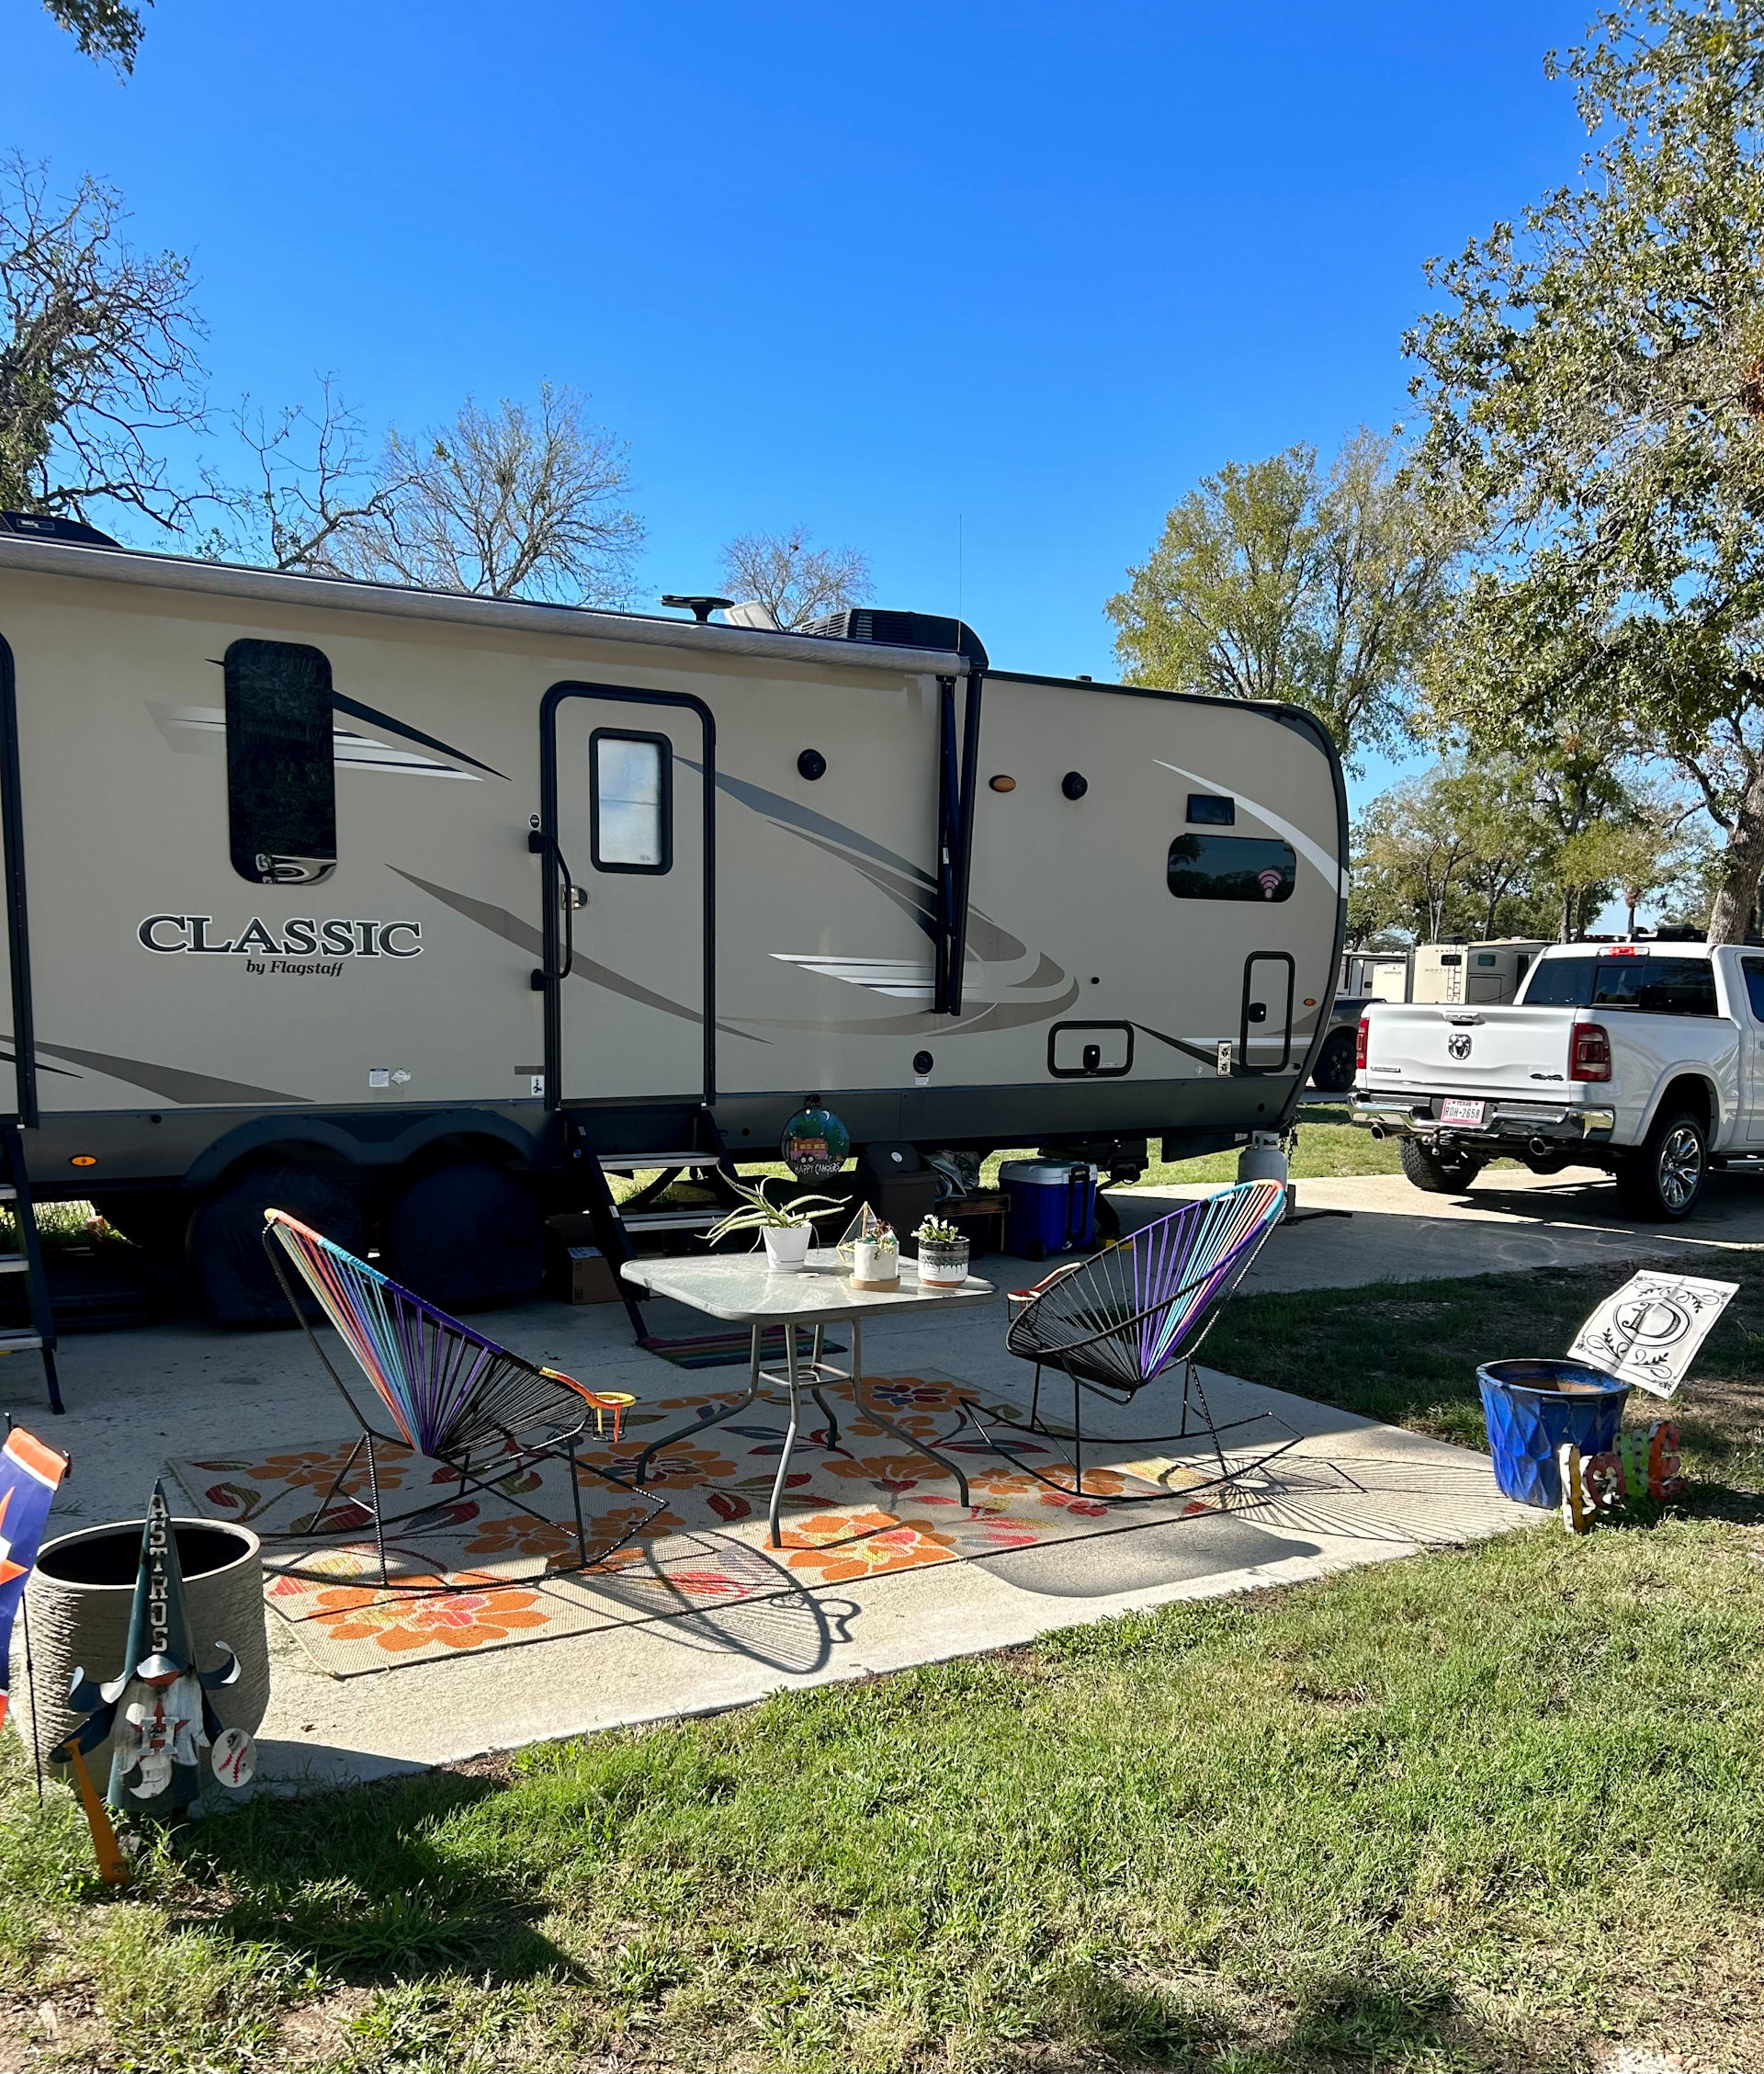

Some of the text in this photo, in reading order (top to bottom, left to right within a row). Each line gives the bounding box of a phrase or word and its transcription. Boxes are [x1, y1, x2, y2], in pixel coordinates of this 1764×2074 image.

[137, 913, 424, 958] CLASSIC
[246, 959, 345, 977] by Flagstaff
[794, 1162, 841, 1175] HAPPY CAMPERS
[149, 1494, 169, 1652] ASTROS
[140, 1716, 180, 1755] H
